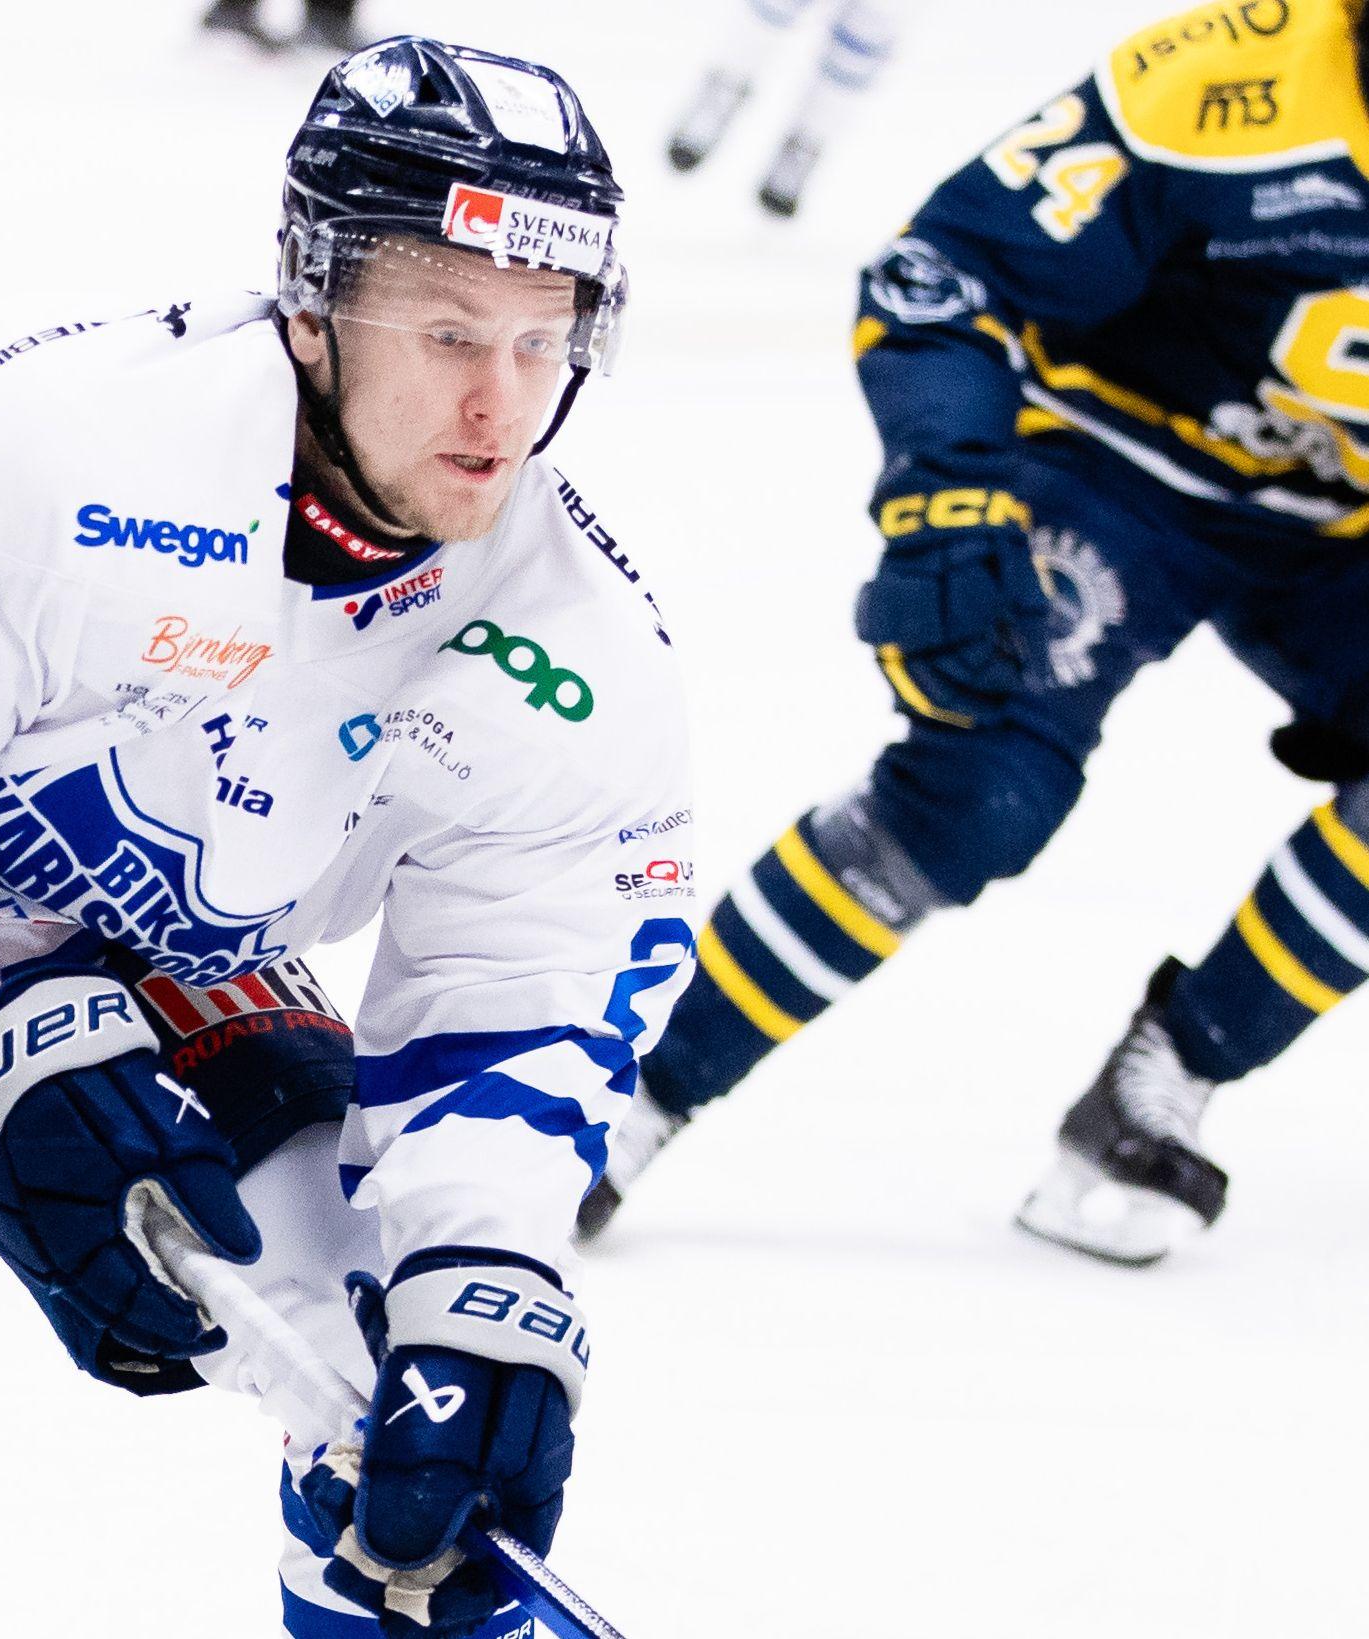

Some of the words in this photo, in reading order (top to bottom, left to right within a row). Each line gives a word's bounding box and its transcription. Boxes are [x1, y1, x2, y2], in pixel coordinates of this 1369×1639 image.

[982, 93, 1130, 243] 24
[509, 211, 600, 250] SVENSKA
[74, 504, 248, 568] Swegon
[384, 567, 444, 602] INTER
[389, 584, 442, 617] SPORT
[408, 727, 420, 740] &
[420, 736, 472, 781] MILJÖ
[97, 846, 181, 946] BIK
